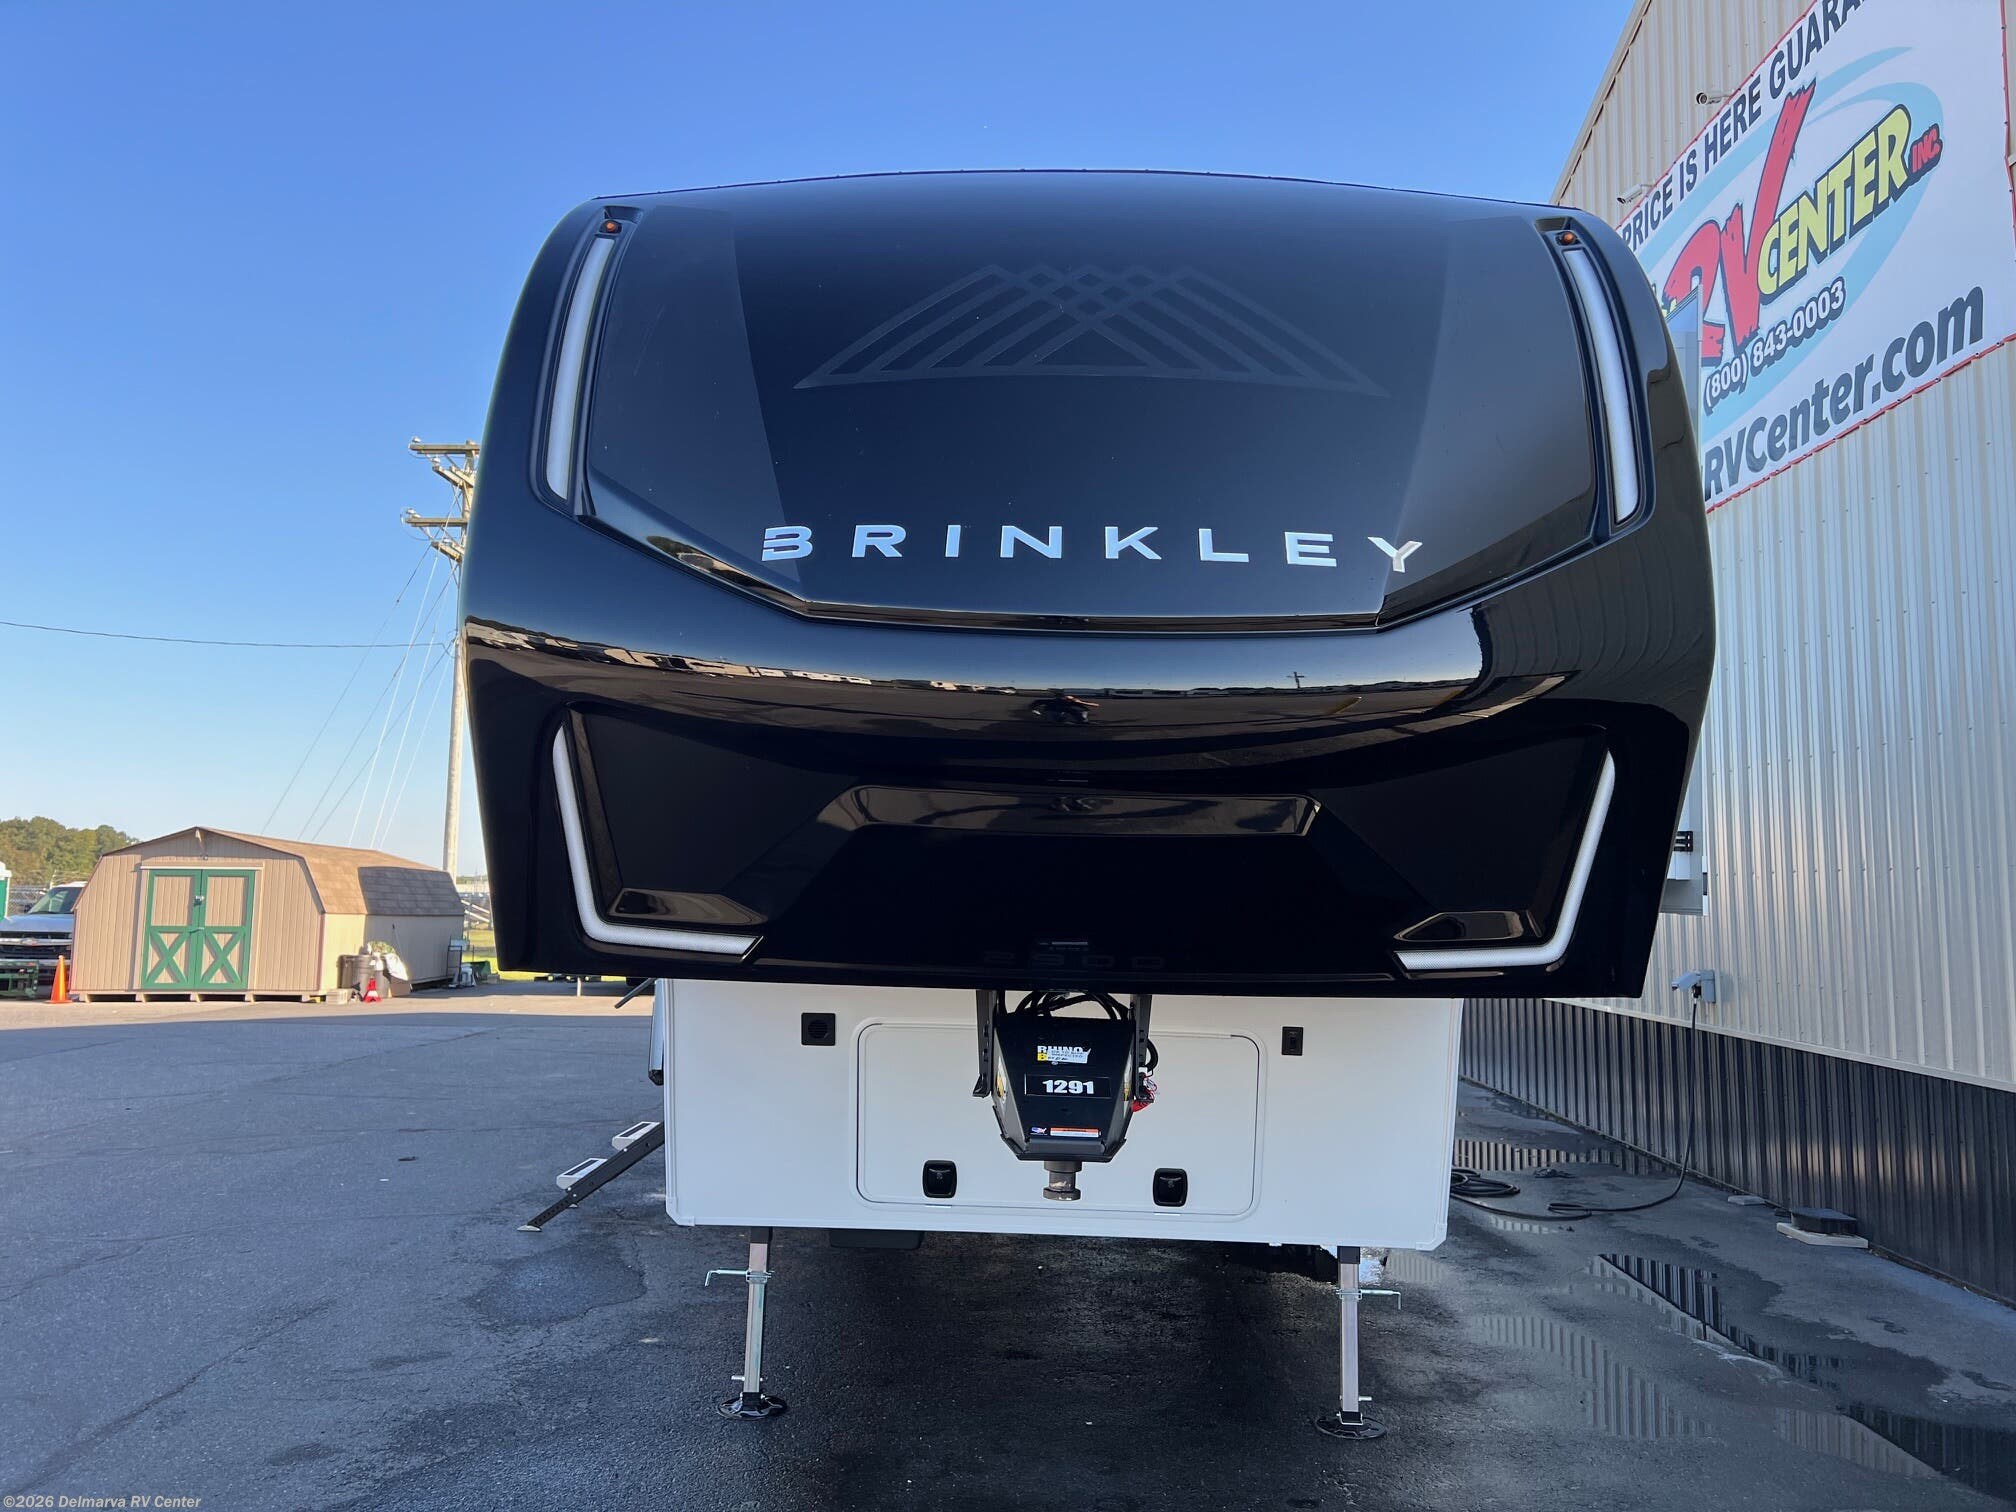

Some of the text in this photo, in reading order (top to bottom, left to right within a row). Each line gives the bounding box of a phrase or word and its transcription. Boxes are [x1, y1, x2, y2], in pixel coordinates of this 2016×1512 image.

[1622, 179, 1673, 252] PRICE
[1679, 150, 1698, 202] IS
[1704, 77, 1763, 174] HERE
[1758, 104, 1911, 304] CENTER
[1911, 124, 1943, 175] INC.
[1704, 352, 1748, 414] (800)
[1750, 277, 1846, 377] 843-0003
[761, 524, 1423, 573] BRINKLEY
[1042, 1079, 1094, 1095] 1291
